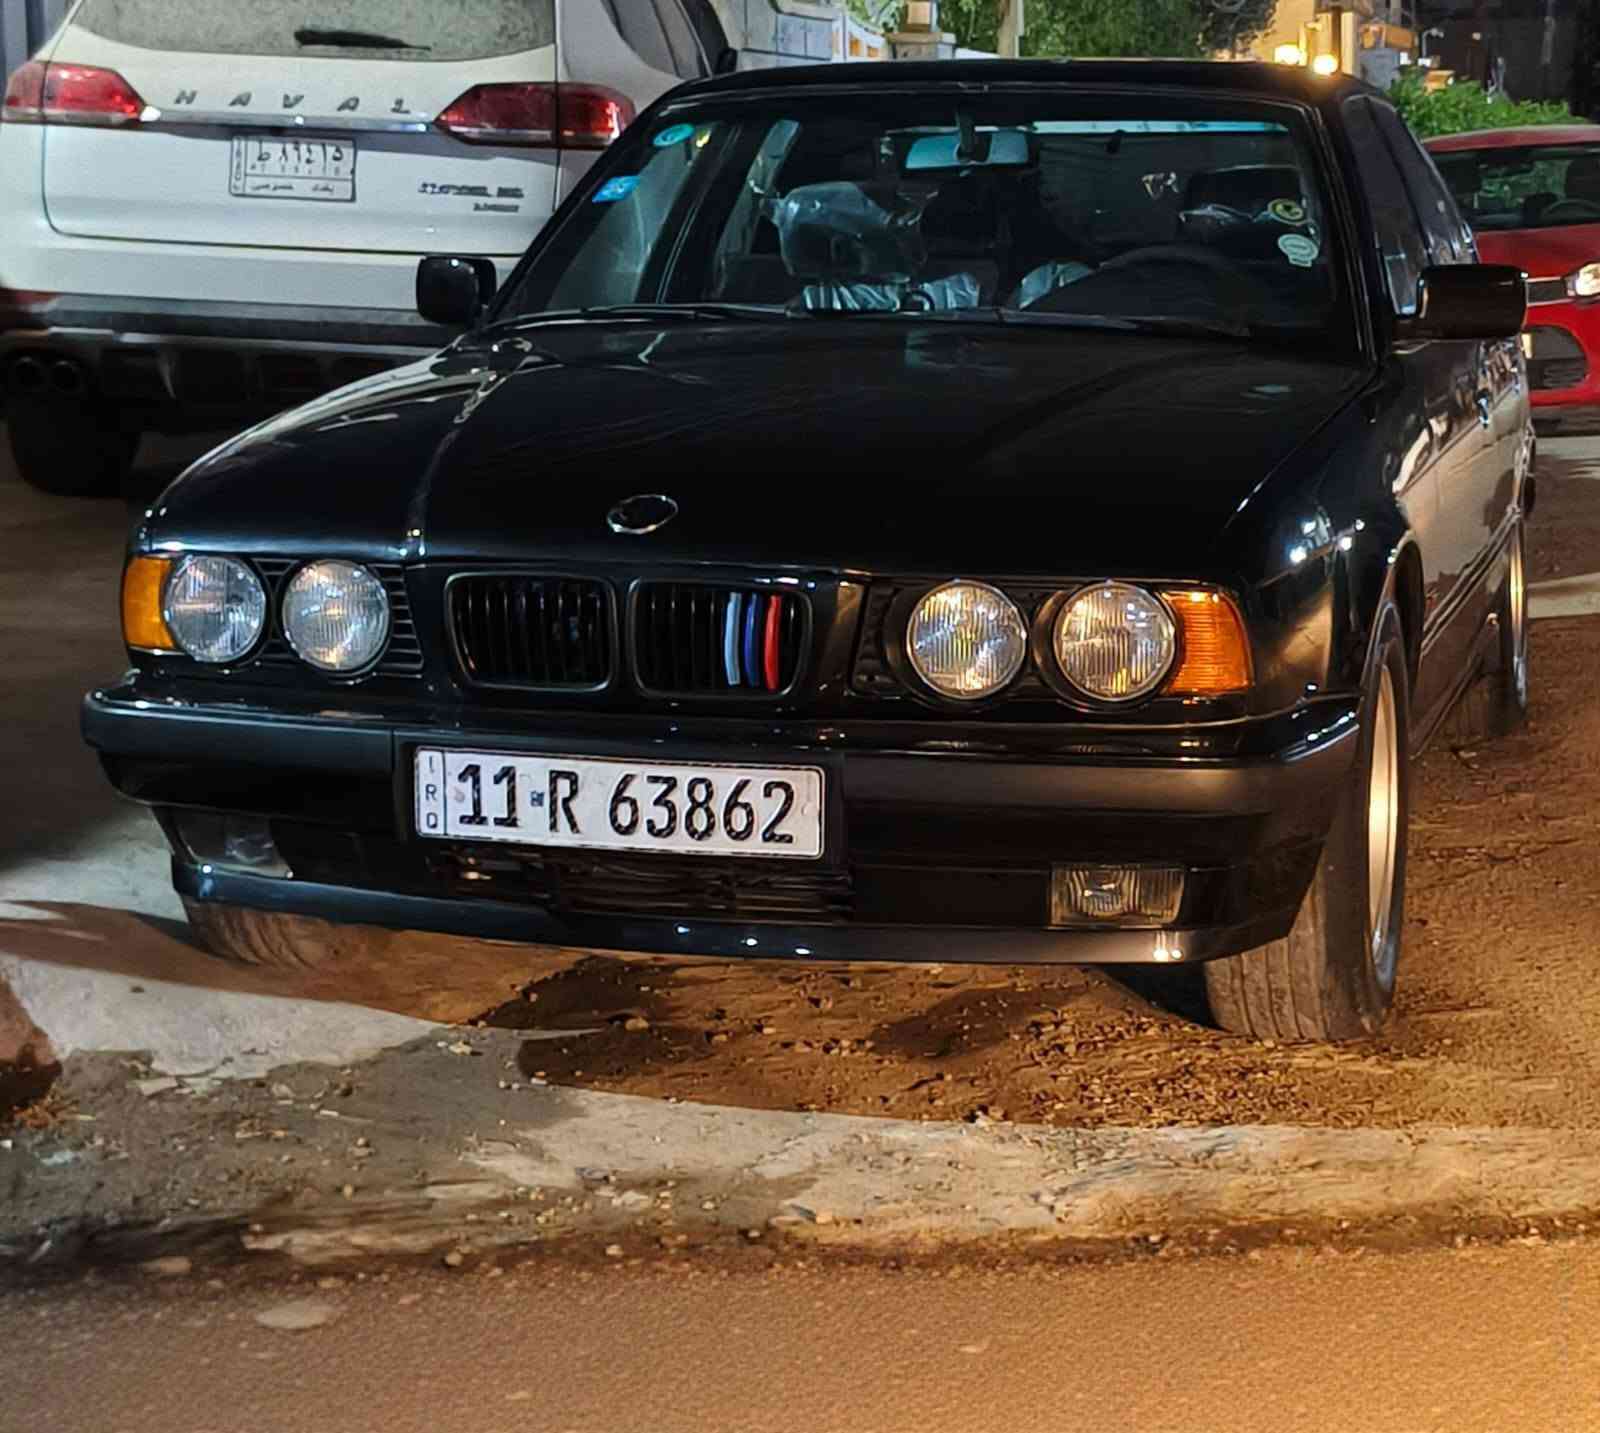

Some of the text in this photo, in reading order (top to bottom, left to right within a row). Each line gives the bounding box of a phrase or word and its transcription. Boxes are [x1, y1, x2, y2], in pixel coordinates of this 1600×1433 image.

[174, 90, 411, 114] HAVAL
[457, 763, 794, 844] 11 R 63862
